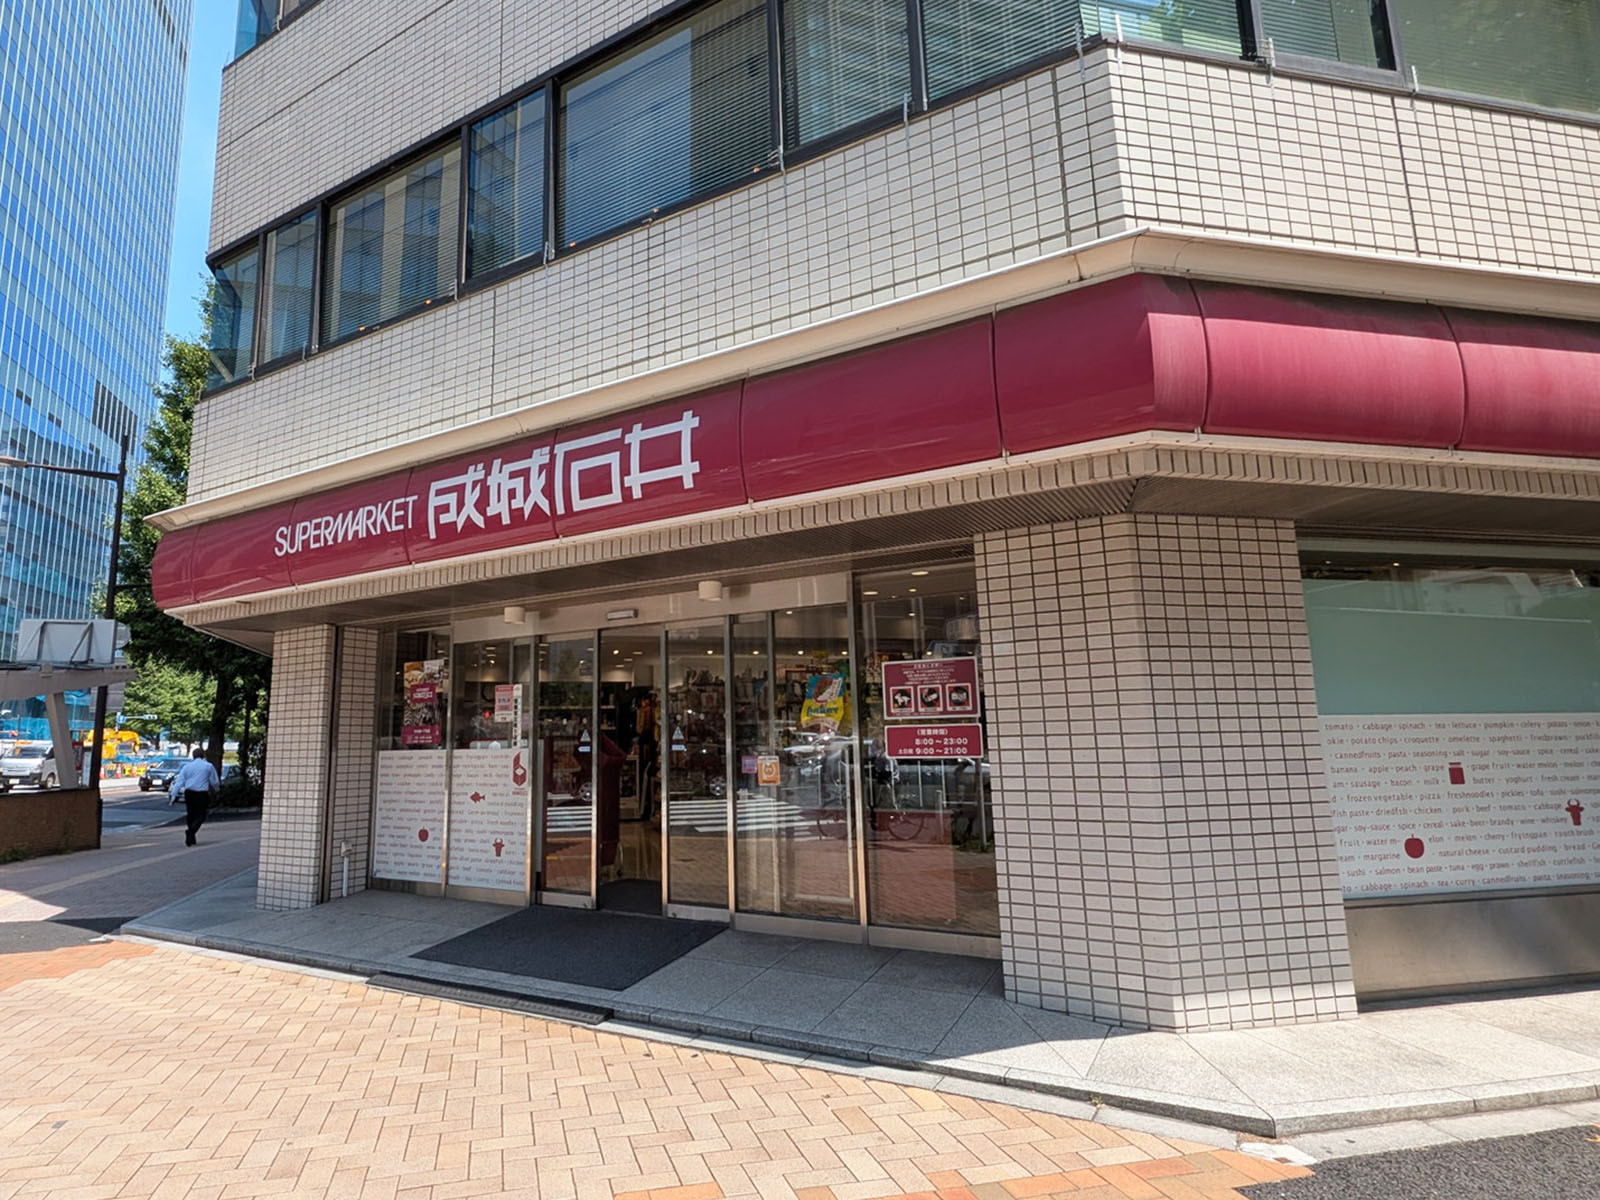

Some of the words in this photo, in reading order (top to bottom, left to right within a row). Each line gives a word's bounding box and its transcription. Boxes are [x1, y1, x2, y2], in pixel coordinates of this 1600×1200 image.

[273, 493, 419, 557] SUPERMARKET
[428, 410, 700, 540] 成城石井
[1324, 723, 1354, 731] tomato
[1362, 721, 1393, 732] cabbage
[1398, 721, 1426, 731] spinach
[1451, 720, 1477, 729] lettuce
[1483, 720, 1514, 730] pumpkin
[1350, 736, 1376, 746] potato
[1377, 735, 1398, 746] chips
[1403, 735, 1439, 745] croquette
[1447, 734, 1480, 743] omelette
[1488, 734, 1522, 744] spaghetti
[1387, 750, 1407, 760] pasta
[1412, 748, 1448, 758] seasoning
[1452, 749, 1465, 757] salt
[1470, 749, 1490, 758] sugar
[1330, 765, 1358, 774] banana
[1368, 764, 1390, 774] apple
[1394, 763, 1418, 774] peach
[1422, 764, 1445, 773] grape
[1470, 763, 1490, 772] grape
[1491, 761, 1510, 770] fruit
[1350, 780, 1381, 789] sausage
[1390, 779, 1412, 787] bacon
[1423, 777, 1440, 785] milk
[1472, 776, 1495, 785] butter
[1346, 794, 1373, 803] frozen
[1373, 791, 1413, 803] vegetable
[1419, 792, 1442, 801] pizza
[1348, 808, 1370, 818] paste
[1413, 805, 1442, 815] chicken
[1452, 805, 1470, 814] pork
[1475, 803, 1491, 813] beef
[1353, 823, 1391, 833] soy-sauce
[1397, 822, 1416, 831] spice
[1422, 820, 1445, 829] cereal
[1449, 819, 1466, 828] sake
[1470, 818, 1485, 827] beer
[1489, 817, 1514, 827] brandy
[1338, 837, 1361, 847] fruit
[1366, 837, 1388, 846] water
[1428, 834, 1445, 843] elon
[1454, 833, 1477, 842] melon
[1483, 832, 1506, 841] cherry
[1362, 852, 1401, 862] margarine
[1438, 848, 1465, 857] natural
[1464, 847, 1490, 857] cheese
[1497, 845, 1526, 855] custard
[1526, 844, 1558, 854] pudding
[1346, 867, 1367, 877] sushi
[1374, 866, 1401, 876] salmon
[1406, 865, 1425, 874] bean
[1425, 864, 1443, 875] paste
[1448, 864, 1465, 872] tuna
[1470, 863, 1485, 872] egg
[1488, 862, 1510, 871] prawn
[1360, 881, 1393, 892] cabbage
[1399, 879, 1429, 890] spinach
[1436, 879, 1449, 888] tea
[1454, 878, 1476, 887] curry
